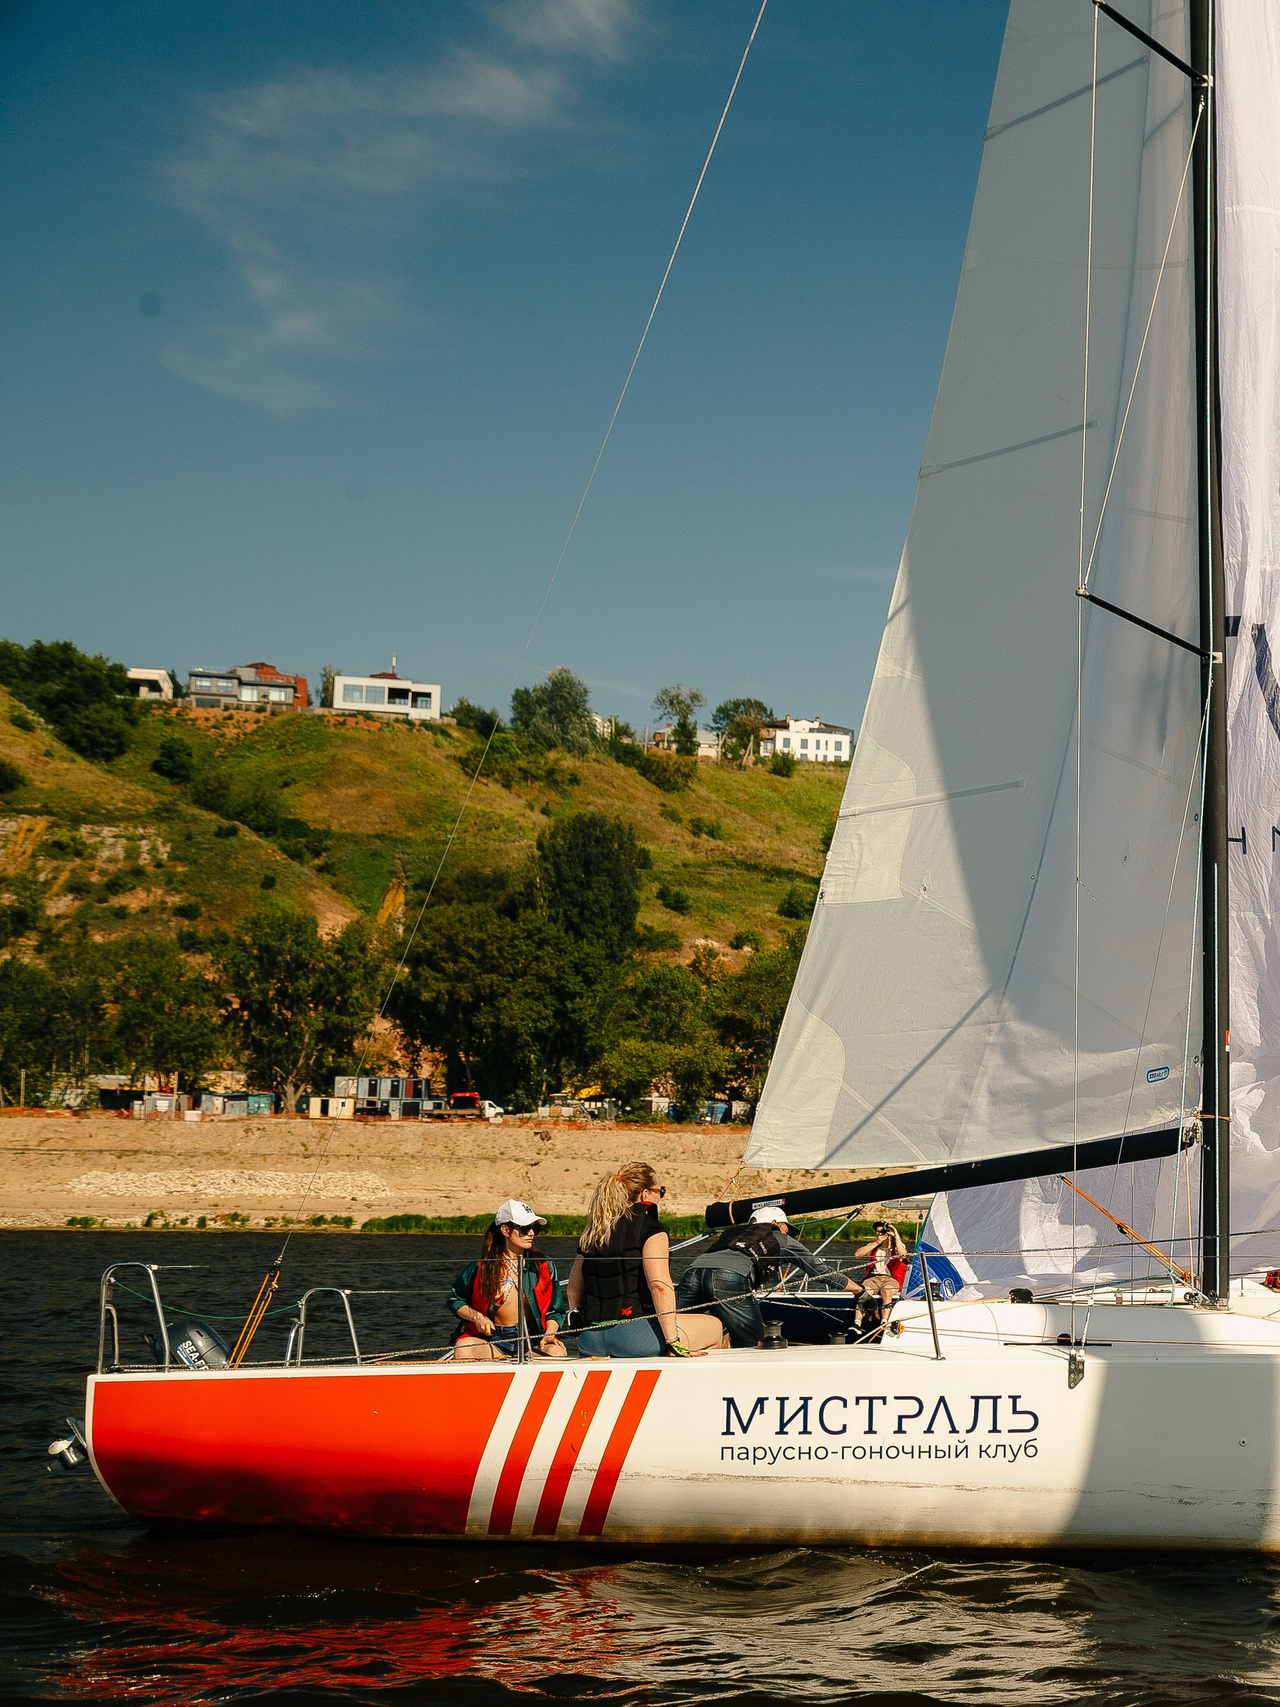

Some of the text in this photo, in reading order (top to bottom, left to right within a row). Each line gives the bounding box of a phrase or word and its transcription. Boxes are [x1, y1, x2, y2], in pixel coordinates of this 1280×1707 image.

[721, 1394, 1040, 1436] МИСТРАЛЬ
[720, 1437, 1039, 1465] парусно-гоночный клуб
